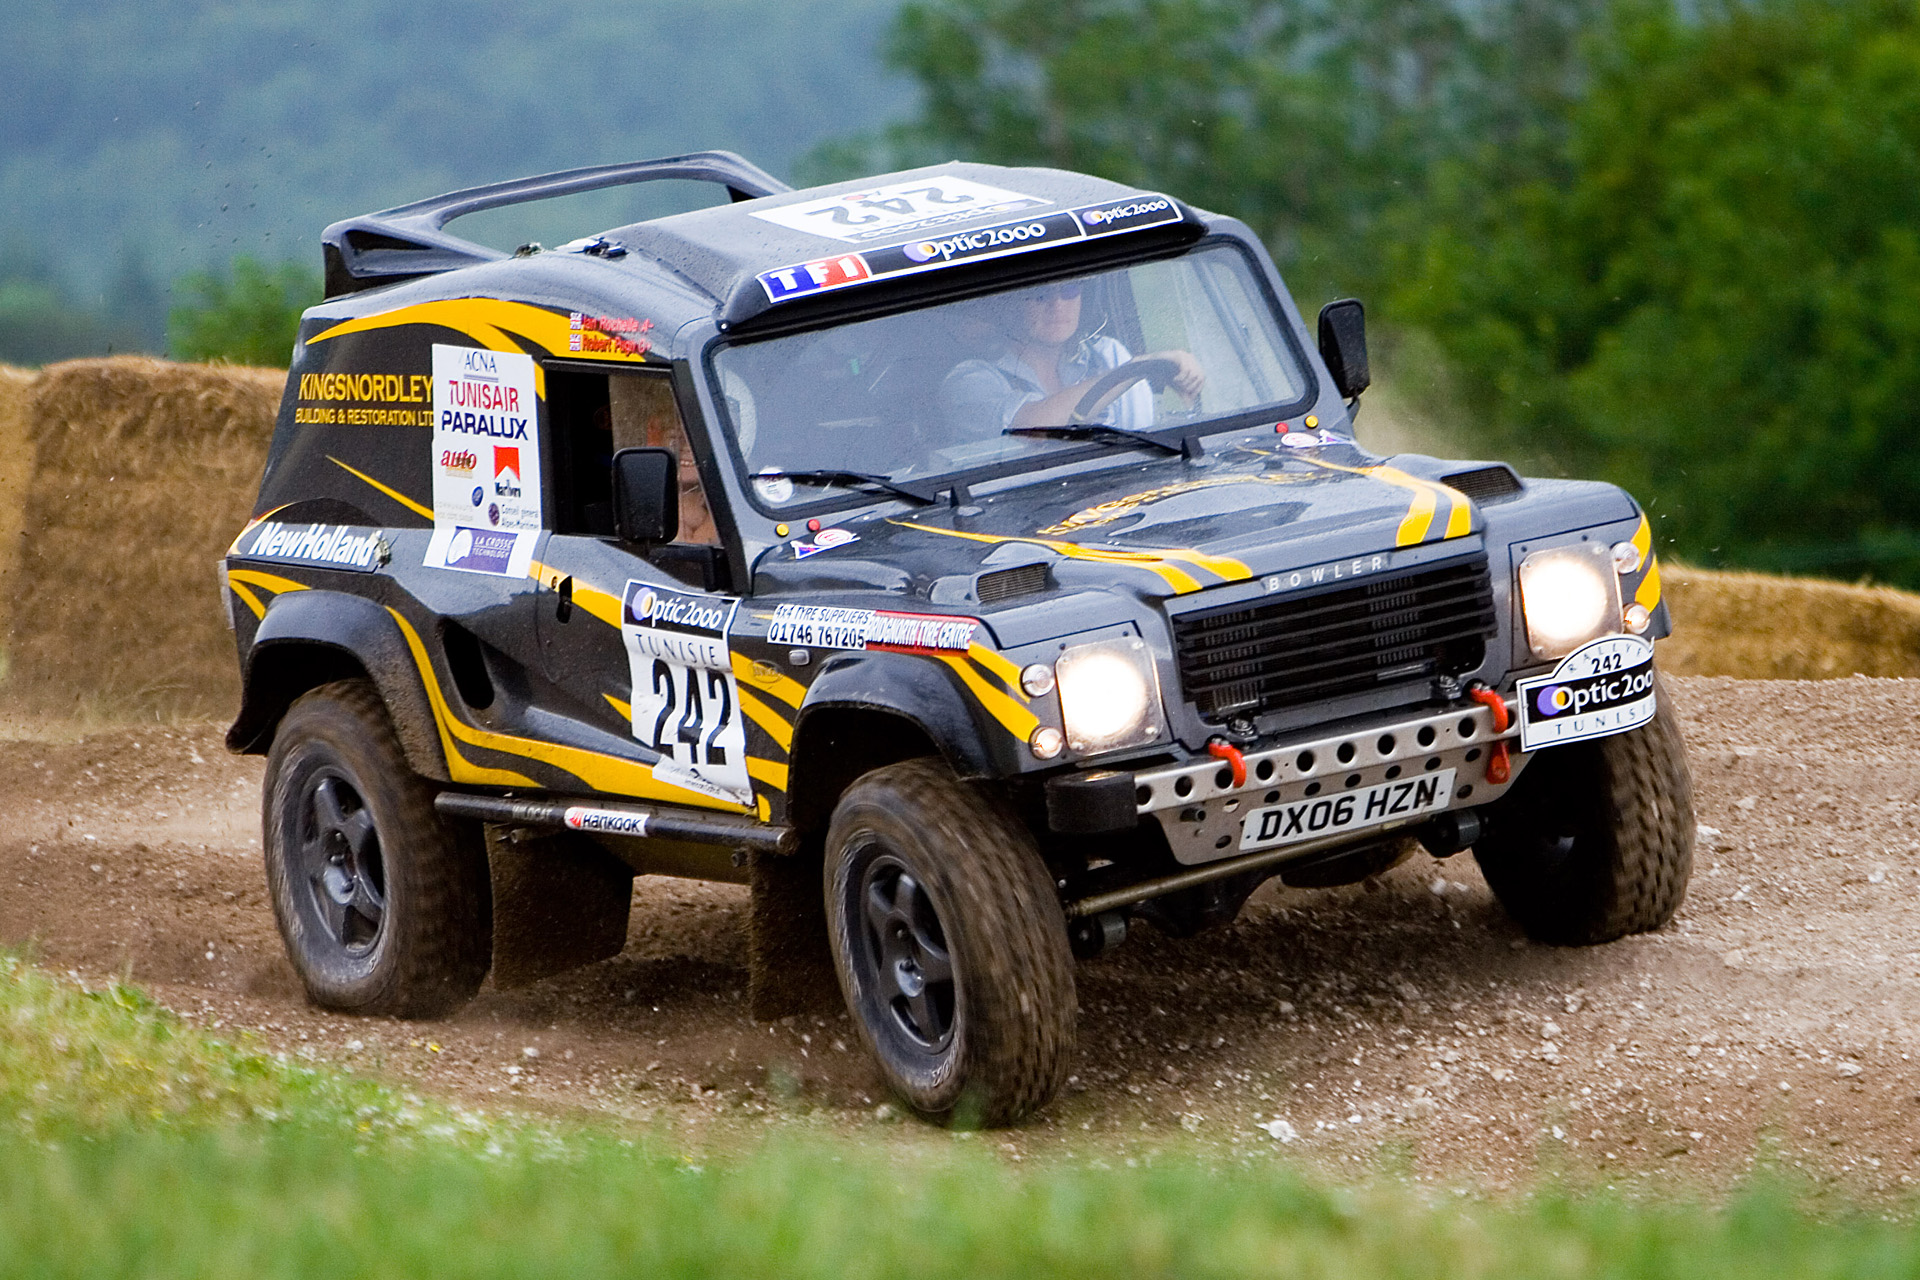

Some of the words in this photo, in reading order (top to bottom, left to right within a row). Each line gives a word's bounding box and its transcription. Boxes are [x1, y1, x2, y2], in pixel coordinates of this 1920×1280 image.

[805, 187, 974, 225] 242
[1092, 199, 1169, 225] Optic2000
[917, 222, 1046, 262] Optic2000
[769, 256, 860, 292] TF1
[464, 351, 497, 374] ACNA
[298, 373, 433, 403] KINGSNORDLEY
[448, 380, 520, 413] TUNISAIR
[295, 407, 336, 424] BUILDING
[337, 408, 346, 424] &
[347, 408, 416, 426] RESTORATION
[441, 410, 529, 441] PARALUX
[441, 449, 477, 470] auto
[473, 547, 510, 559] TECHNOLOGY
[474, 536, 486, 545] LA
[486, 537, 515, 549] CROSSE
[1269, 556, 1383, 591] BOWLER
[641, 592, 723, 629] Optic2000
[775, 605, 795, 618] 4x4
[795, 606, 816, 621] TYRE
[818, 608, 870, 625] SUPPLIERS
[635, 633, 719, 667] TUNISIE
[770, 622, 813, 644] 01746
[818, 625, 866, 649] 767205
[938, 622, 977, 650] CENTRE
[1591, 653, 1622, 675] 242
[1551, 669, 1654, 715] Optic200
[652, 658, 731, 766] 242
[1256, 795, 1357, 842] DX06
[1364, 776, 1440, 820] HZN
